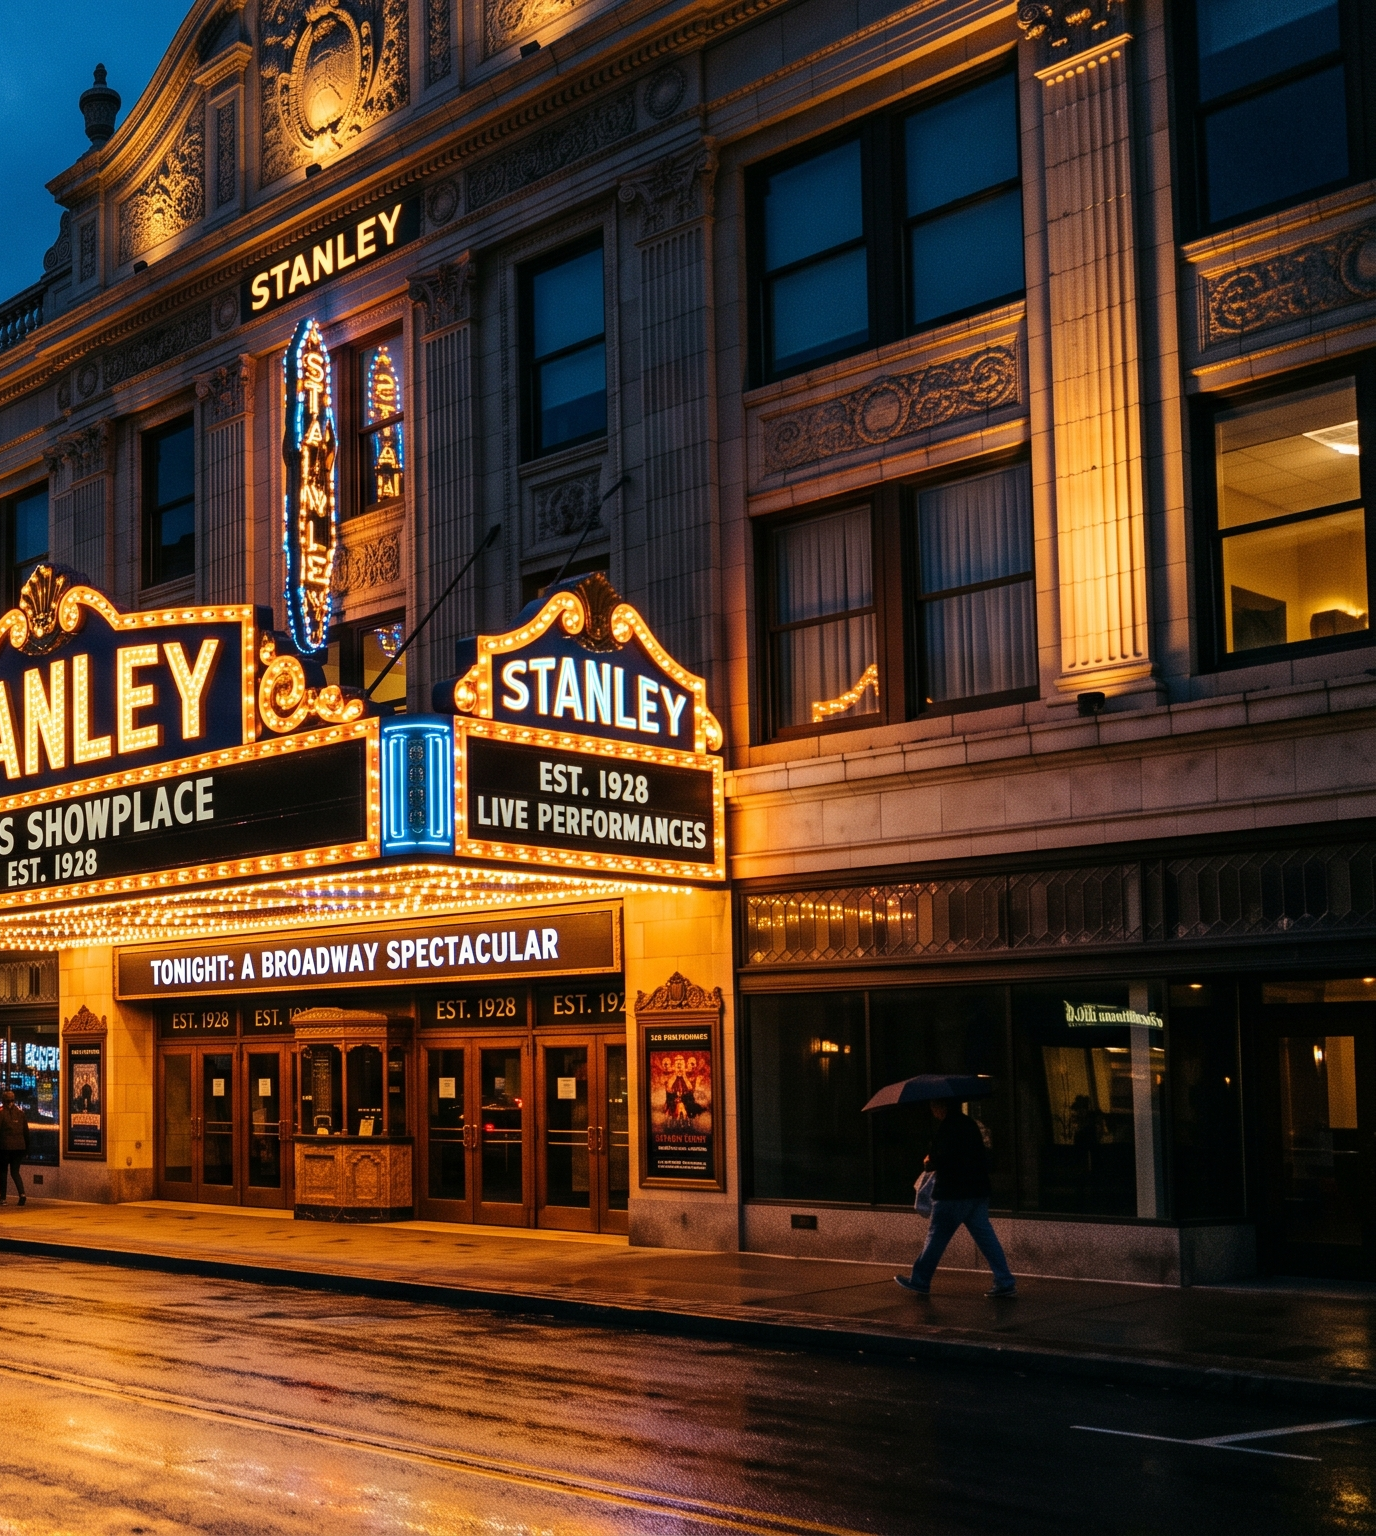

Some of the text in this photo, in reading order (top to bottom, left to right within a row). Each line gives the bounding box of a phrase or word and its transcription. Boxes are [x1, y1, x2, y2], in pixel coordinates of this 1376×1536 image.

[250, 204, 402, 310] STANLEY
[501, 657, 686, 737] STANLEY
[540, 761, 649, 804] EST. 1928
[27, 777, 214, 850] SHOWPLACE
[478, 795, 706, 849] LIVE PERFORMANCES
[8, 849, 97, 887] EST. 1928
[151, 928, 559, 985] TONIGHT: A BROADWAY SPECTACULAR
[173, 1011, 229, 1029] EST. 1928
[255, 1009, 283, 1026] EST.
[436, 997, 516, 1020] EST. 1928
[553, 994, 592, 1015] EST.
